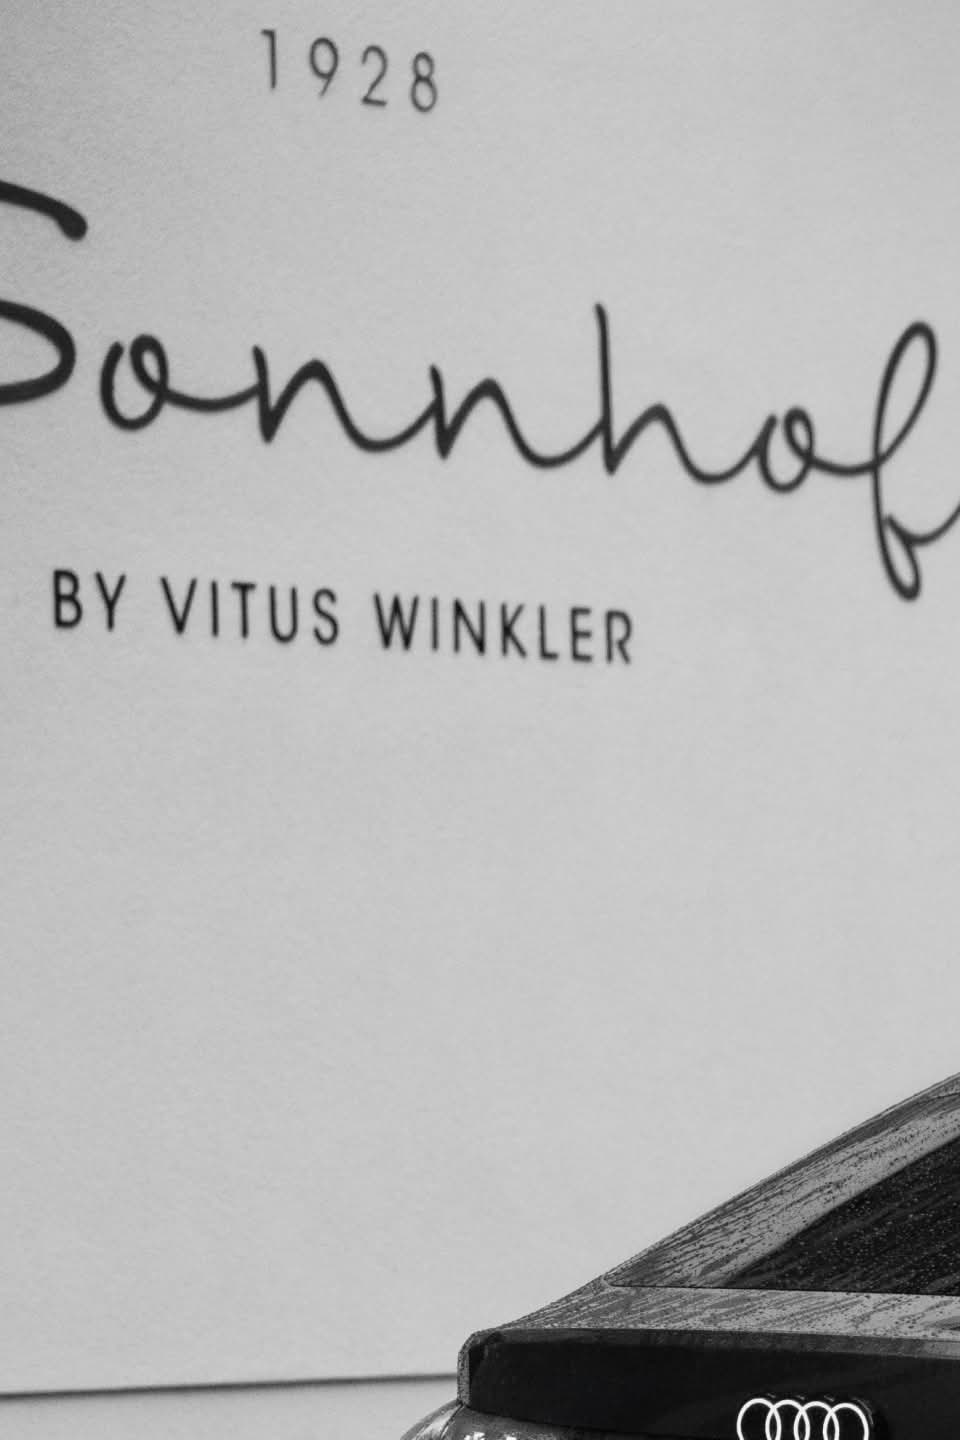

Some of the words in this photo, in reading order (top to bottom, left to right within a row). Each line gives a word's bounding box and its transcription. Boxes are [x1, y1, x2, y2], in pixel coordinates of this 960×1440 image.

[261, 29, 438, 112] 1928
[52, 569, 126, 631] BY
[160, 576, 340, 646] VITUS
[373, 593, 632, 663] WINKLER
